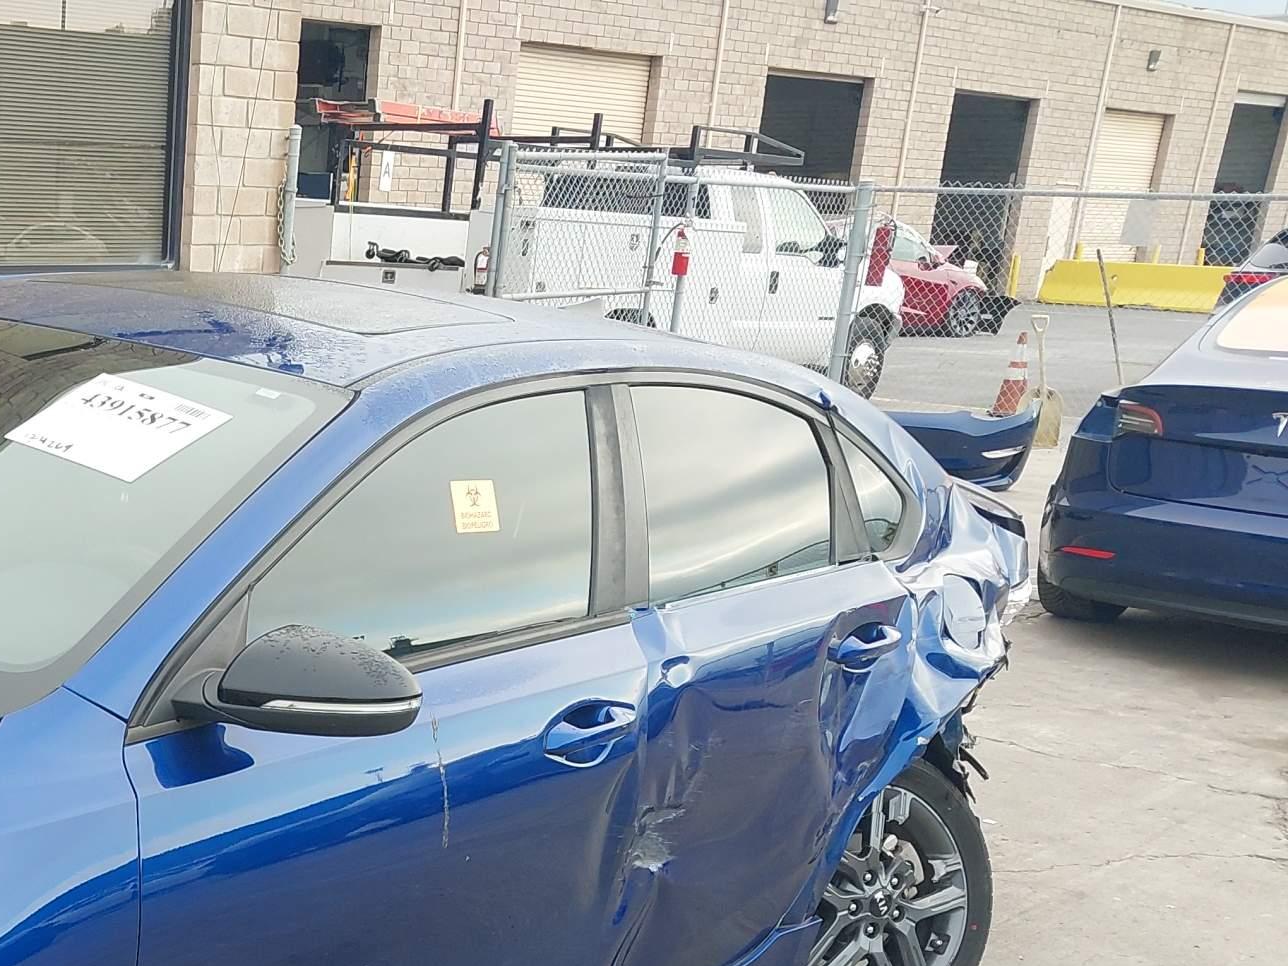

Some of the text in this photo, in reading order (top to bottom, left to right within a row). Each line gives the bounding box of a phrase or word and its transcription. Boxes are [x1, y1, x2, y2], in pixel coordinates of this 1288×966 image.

[382, 161, 391, 178] A
[81, 393, 192, 434] 43915877
[874, 891, 889, 916] KIA
